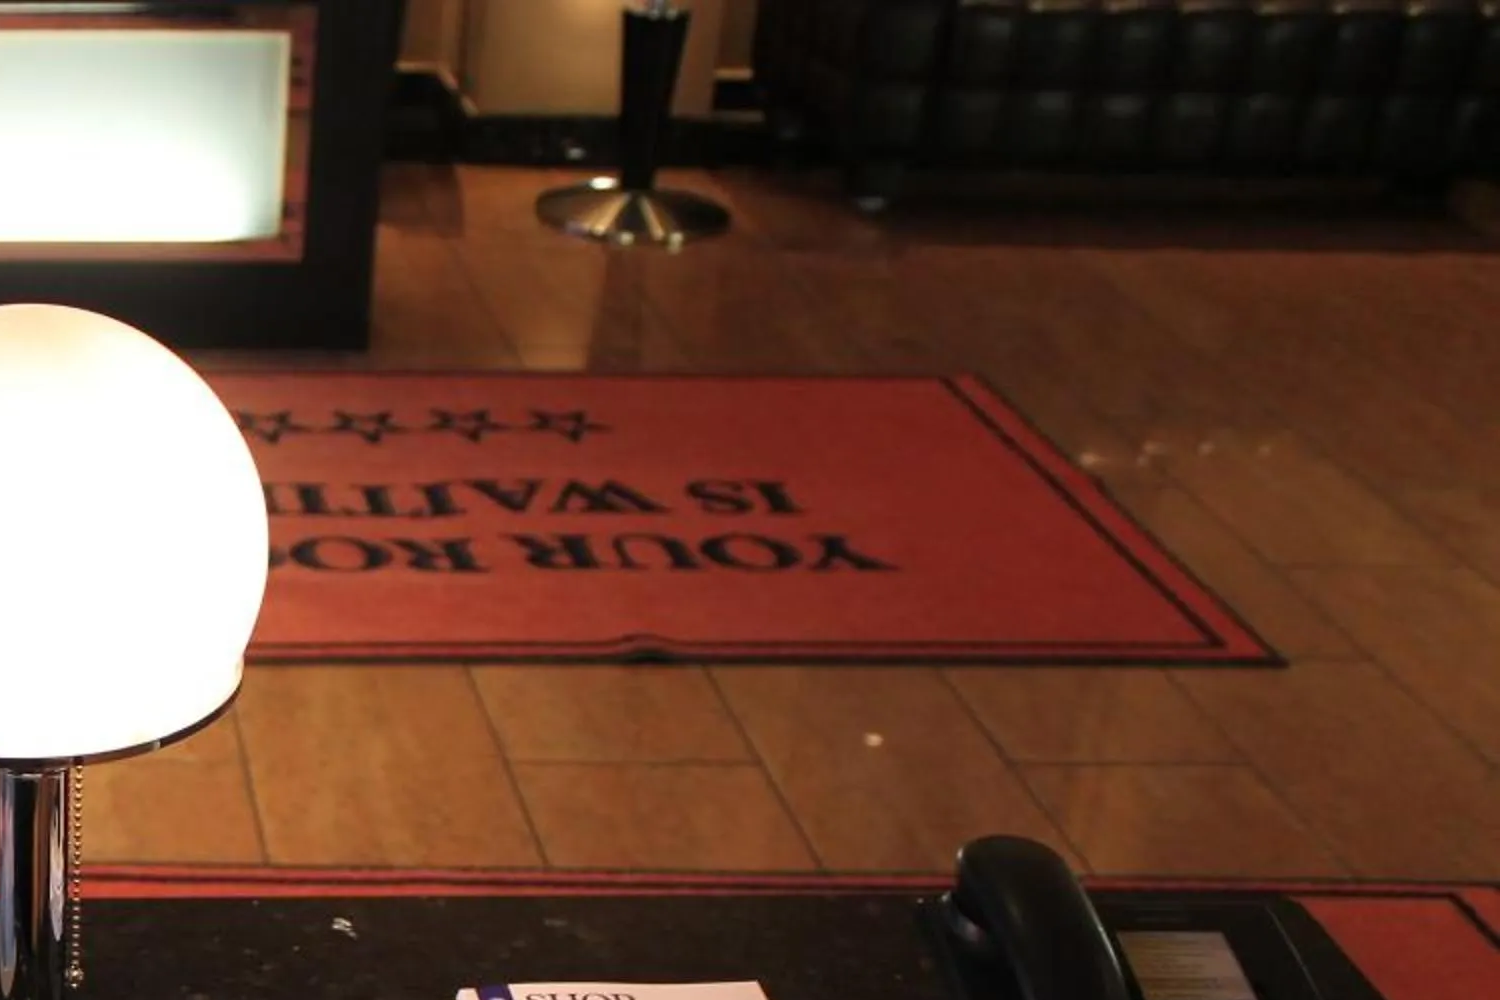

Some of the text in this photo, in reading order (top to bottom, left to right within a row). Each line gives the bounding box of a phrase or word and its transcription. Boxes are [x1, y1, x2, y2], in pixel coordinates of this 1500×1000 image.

[686, 479, 810, 516] IS
[268, 532, 902, 574] YOUR RO
